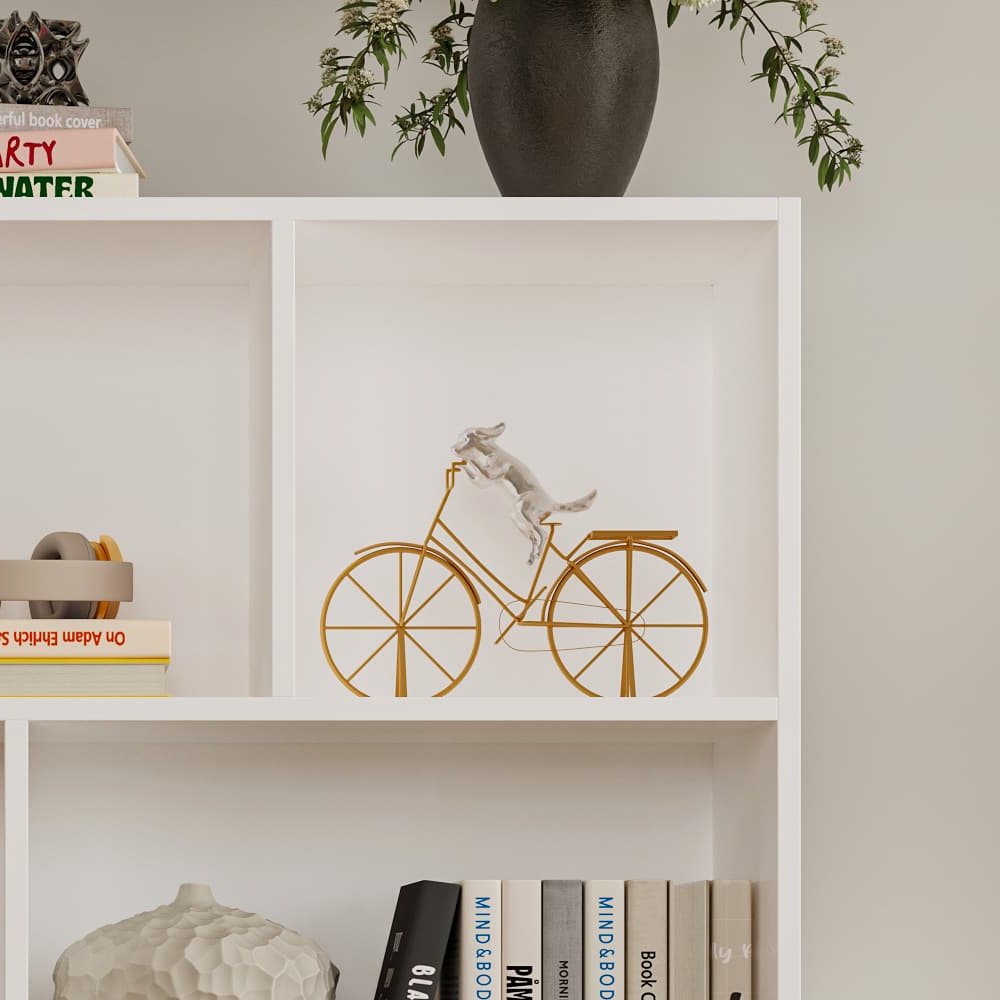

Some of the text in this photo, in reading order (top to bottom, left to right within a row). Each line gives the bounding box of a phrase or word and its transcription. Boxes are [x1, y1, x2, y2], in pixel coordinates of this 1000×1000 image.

[28, 112, 62, 127] book
[64, 117, 101, 129] cover
[14, 632, 57, 646] Ehrlich
[63, 632, 101, 646] Adam
[106, 632, 125, 645] On
[640, 951, 656, 988] Book
